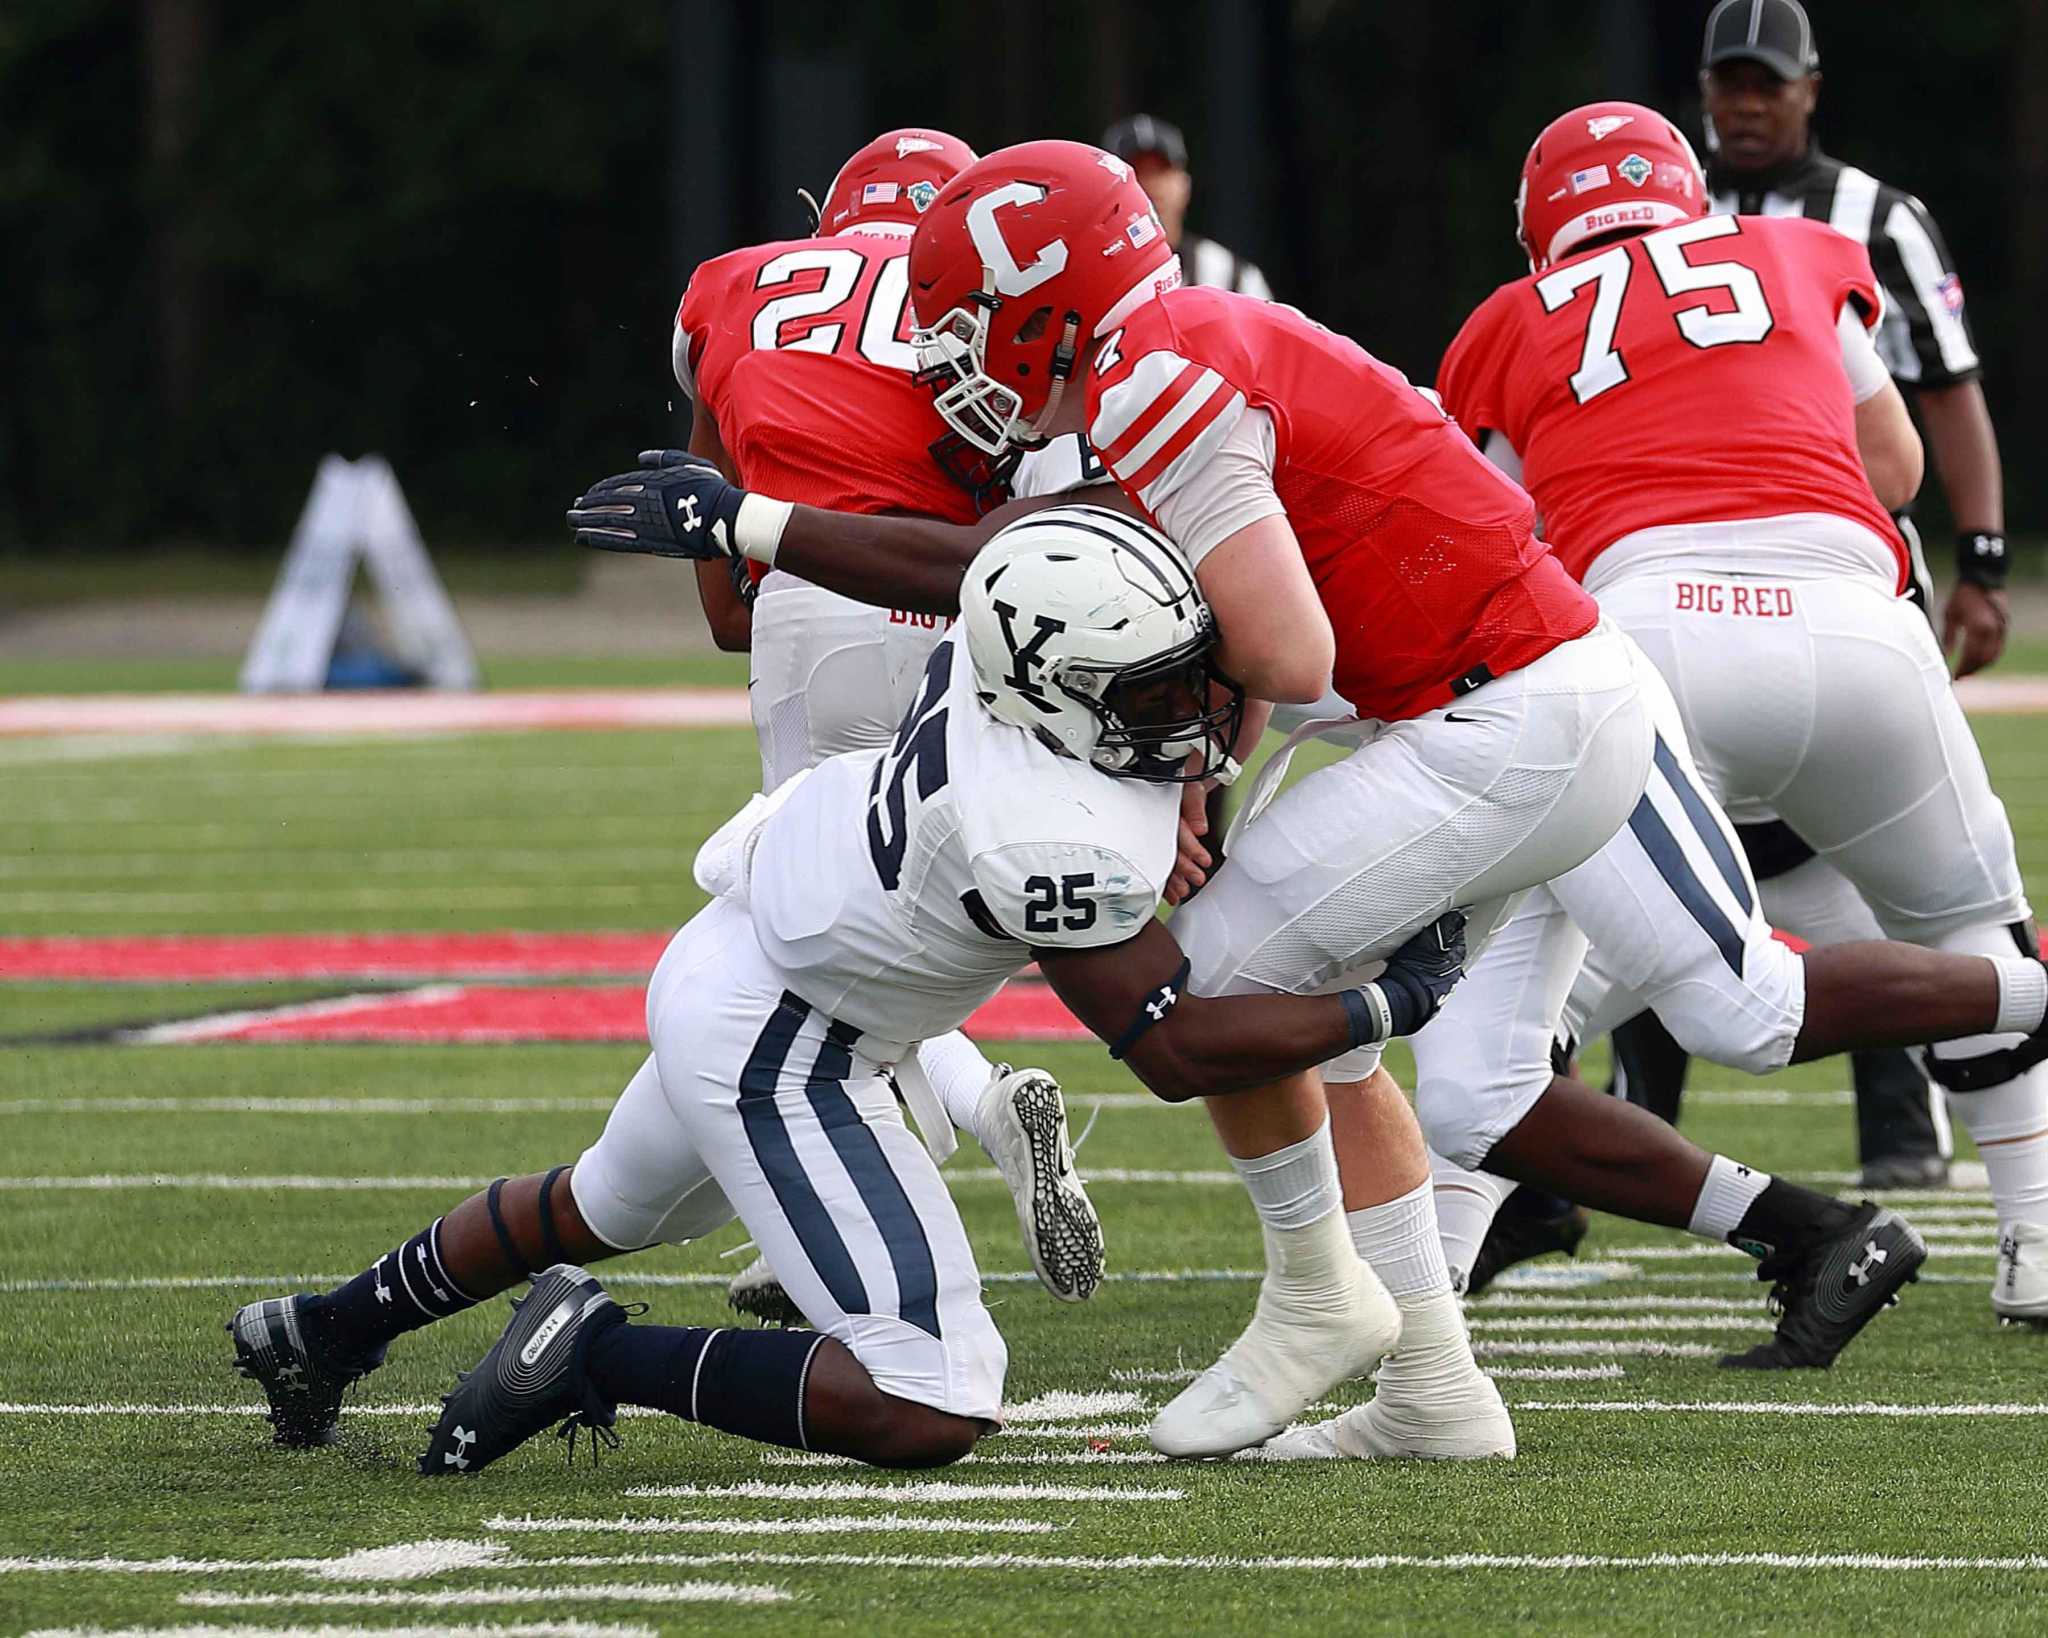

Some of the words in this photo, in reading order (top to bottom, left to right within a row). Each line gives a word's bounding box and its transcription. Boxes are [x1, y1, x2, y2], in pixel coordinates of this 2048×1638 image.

[965, 181, 1069, 297] C
[1535, 214, 1775, 406] 75
[1676, 583, 1723, 613] BIG
[1732, 587, 1793, 617] RED
[1024, 872, 1097, 932] 25
